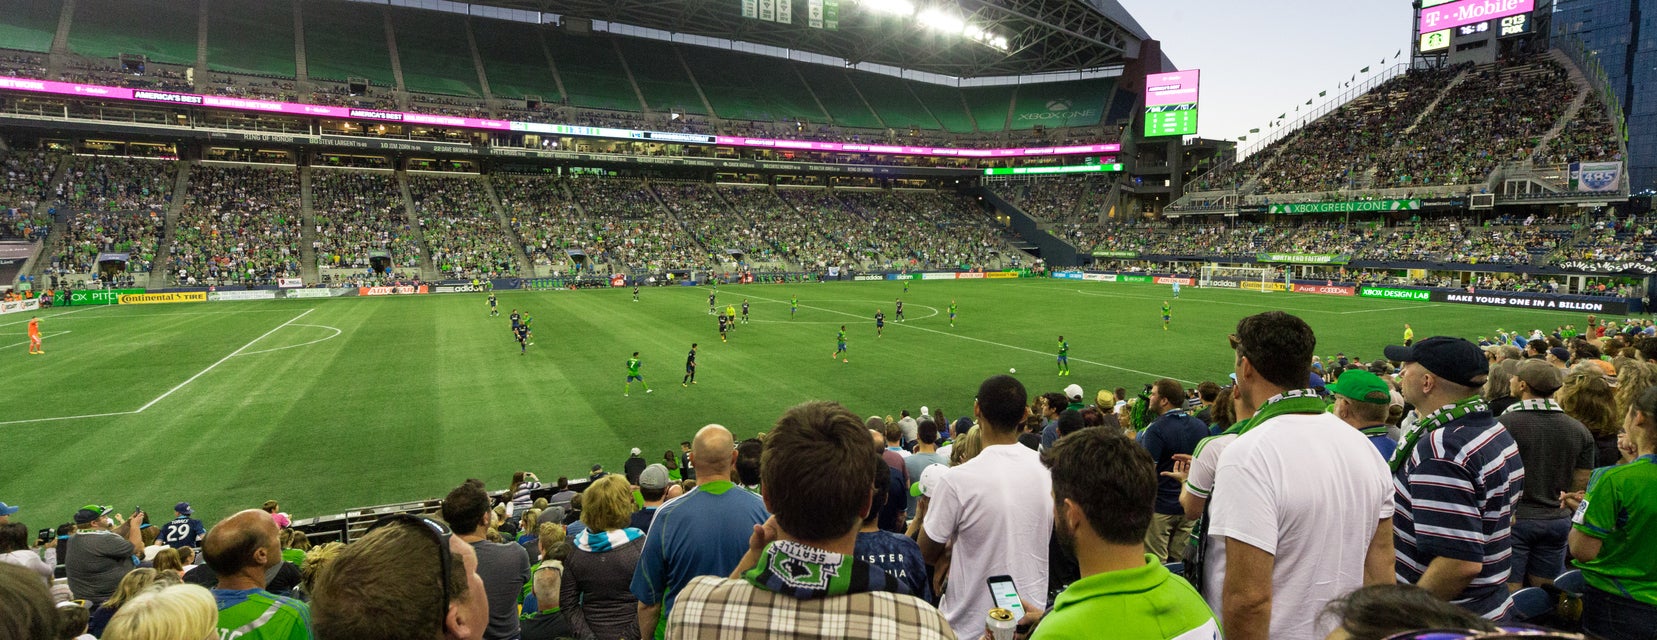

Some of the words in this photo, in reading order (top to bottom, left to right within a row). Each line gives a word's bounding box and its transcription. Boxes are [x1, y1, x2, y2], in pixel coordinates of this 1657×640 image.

[1501, 14, 1526, 27] Q13
[1501, 23, 1524, 36] FOX
[134, 91, 180, 102] AMERICA'S
[180, 96, 202, 104] BEST
[350, 110, 386, 119] AMERICA'S
[1017, 112, 1060, 121] XBOX
[1062, 109, 1097, 120] ONE
[244, 133, 261, 141] RING
[271, 135, 294, 143] HONOR
[1294, 203, 1320, 213] XBOX
[1320, 203, 1355, 212] GREEN
[1356, 201, 1388, 211] ZONE
[56, 293, 88, 302] XOX
[121, 293, 174, 304] Continental
[1363, 288, 1383, 297] XBOX
[1384, 290, 1412, 299] DESIGN
[1413, 292, 1429, 300] LAB
[1447, 294, 1473, 302] MAKE
[1475, 296, 1506, 304] YOURS
[1509, 298, 1530, 306] ONE
[1532, 299, 1545, 307] IN
[1558, 301, 1603, 311] BILLION
[166, 523, 190, 542] 29
[778, 540, 827, 563] SEATTLE
